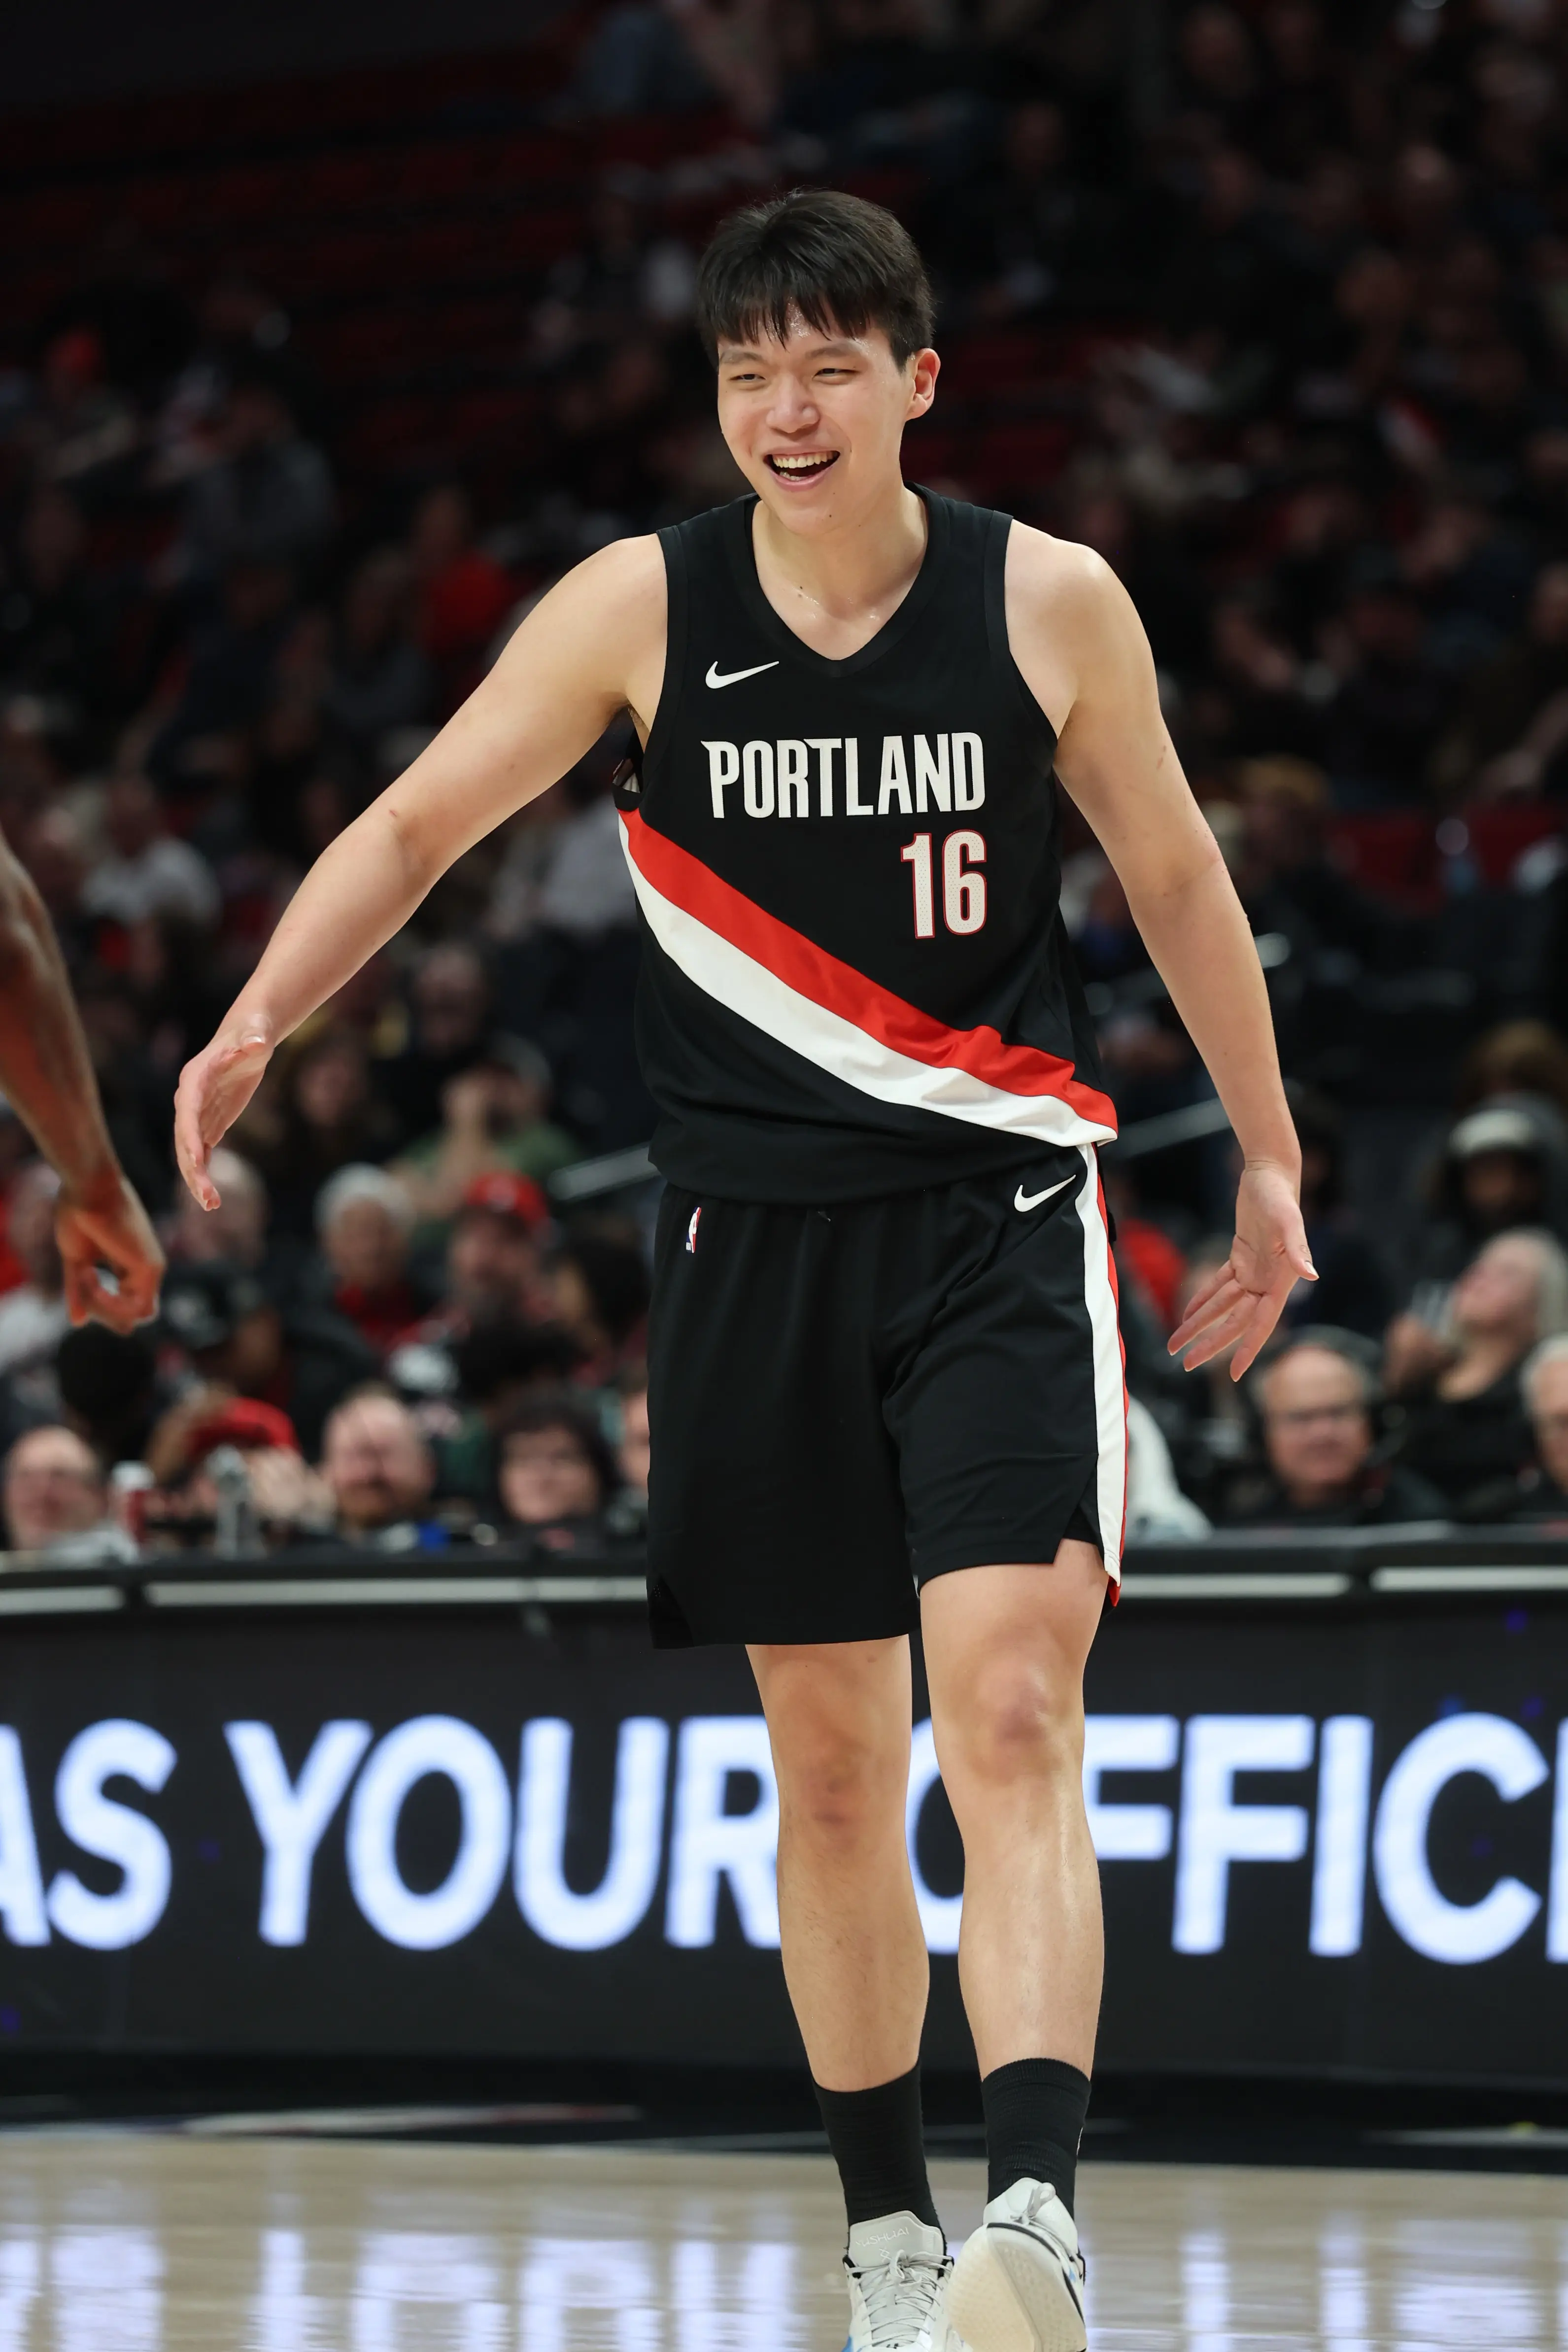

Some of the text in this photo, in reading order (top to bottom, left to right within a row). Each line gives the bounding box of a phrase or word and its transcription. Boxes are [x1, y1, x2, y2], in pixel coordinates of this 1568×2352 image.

[701, 732, 985, 818] PORTLAND
[901, 829, 987, 939] 16
[222, 1713, 782, 1951] YOUR
[905, 1712, 1568, 1965] FFIC
